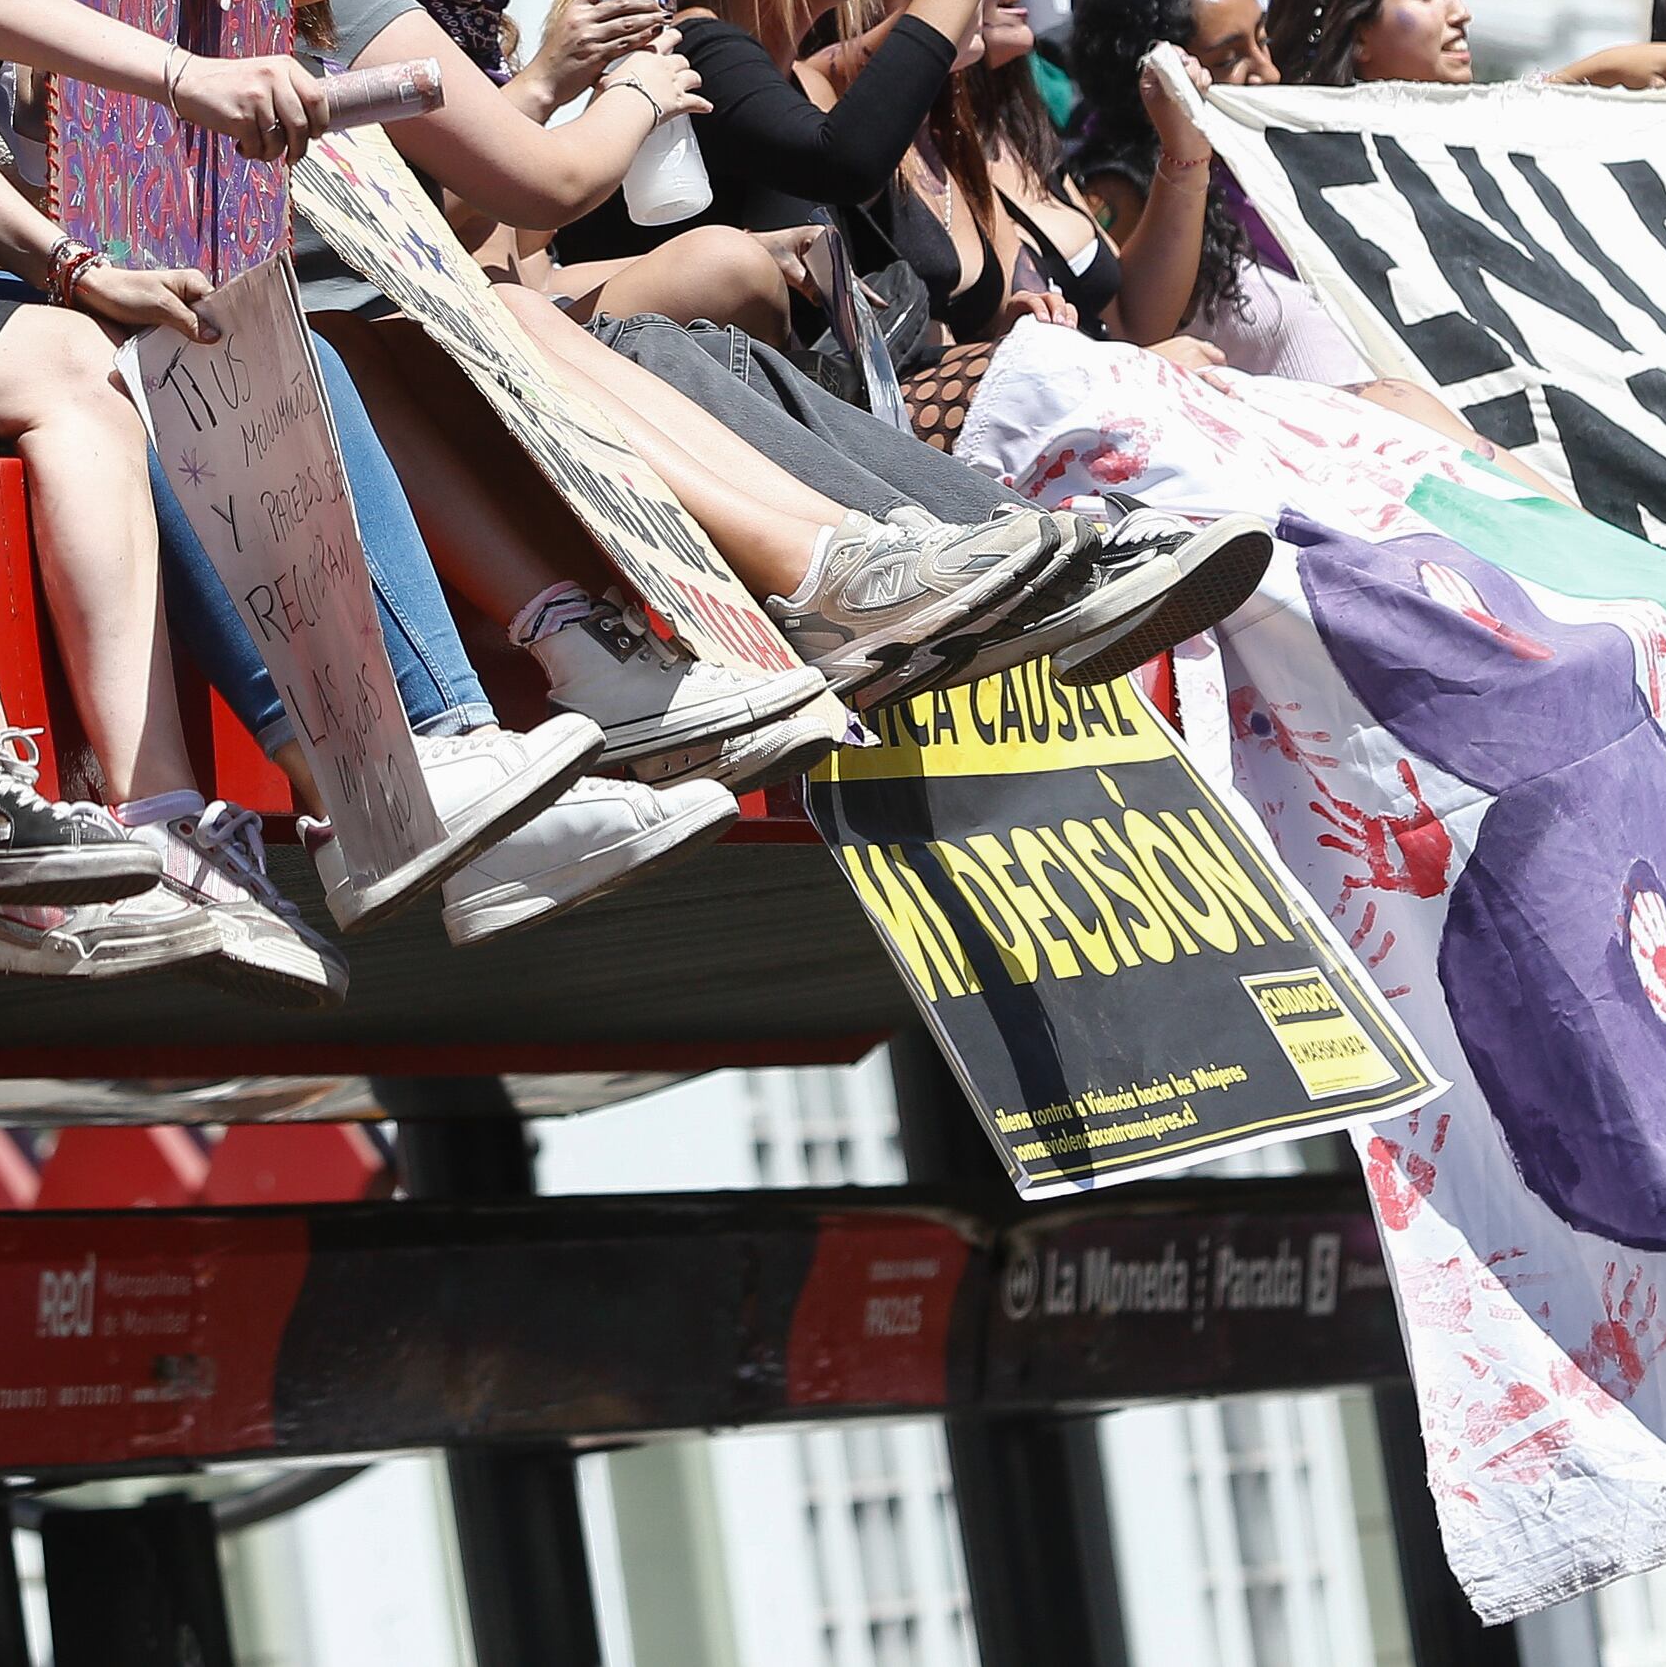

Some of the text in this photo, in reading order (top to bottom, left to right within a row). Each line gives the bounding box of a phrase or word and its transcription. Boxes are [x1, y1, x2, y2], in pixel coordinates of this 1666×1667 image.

[1264, 127, 1634, 384] EN
[210, 494, 243, 553] Y
[286, 663, 344, 747] LAS
[841, 767, 1295, 1002] MI DECISIÓN
[1259, 982, 1337, 1025] ¡CUIDADO!
[1033, 1102, 1074, 1126] contra
[1081, 1084, 1139, 1115] Violencia
[1131, 1077, 1176, 1106] hacia
[1167, 1072, 1198, 1097] las
[1191, 1062, 1249, 1092] Mujeres
[1044, 1248, 1077, 1315] La
[1083, 1238, 1190, 1315] Moneda
[1215, 1238, 1303, 1308] Parada
